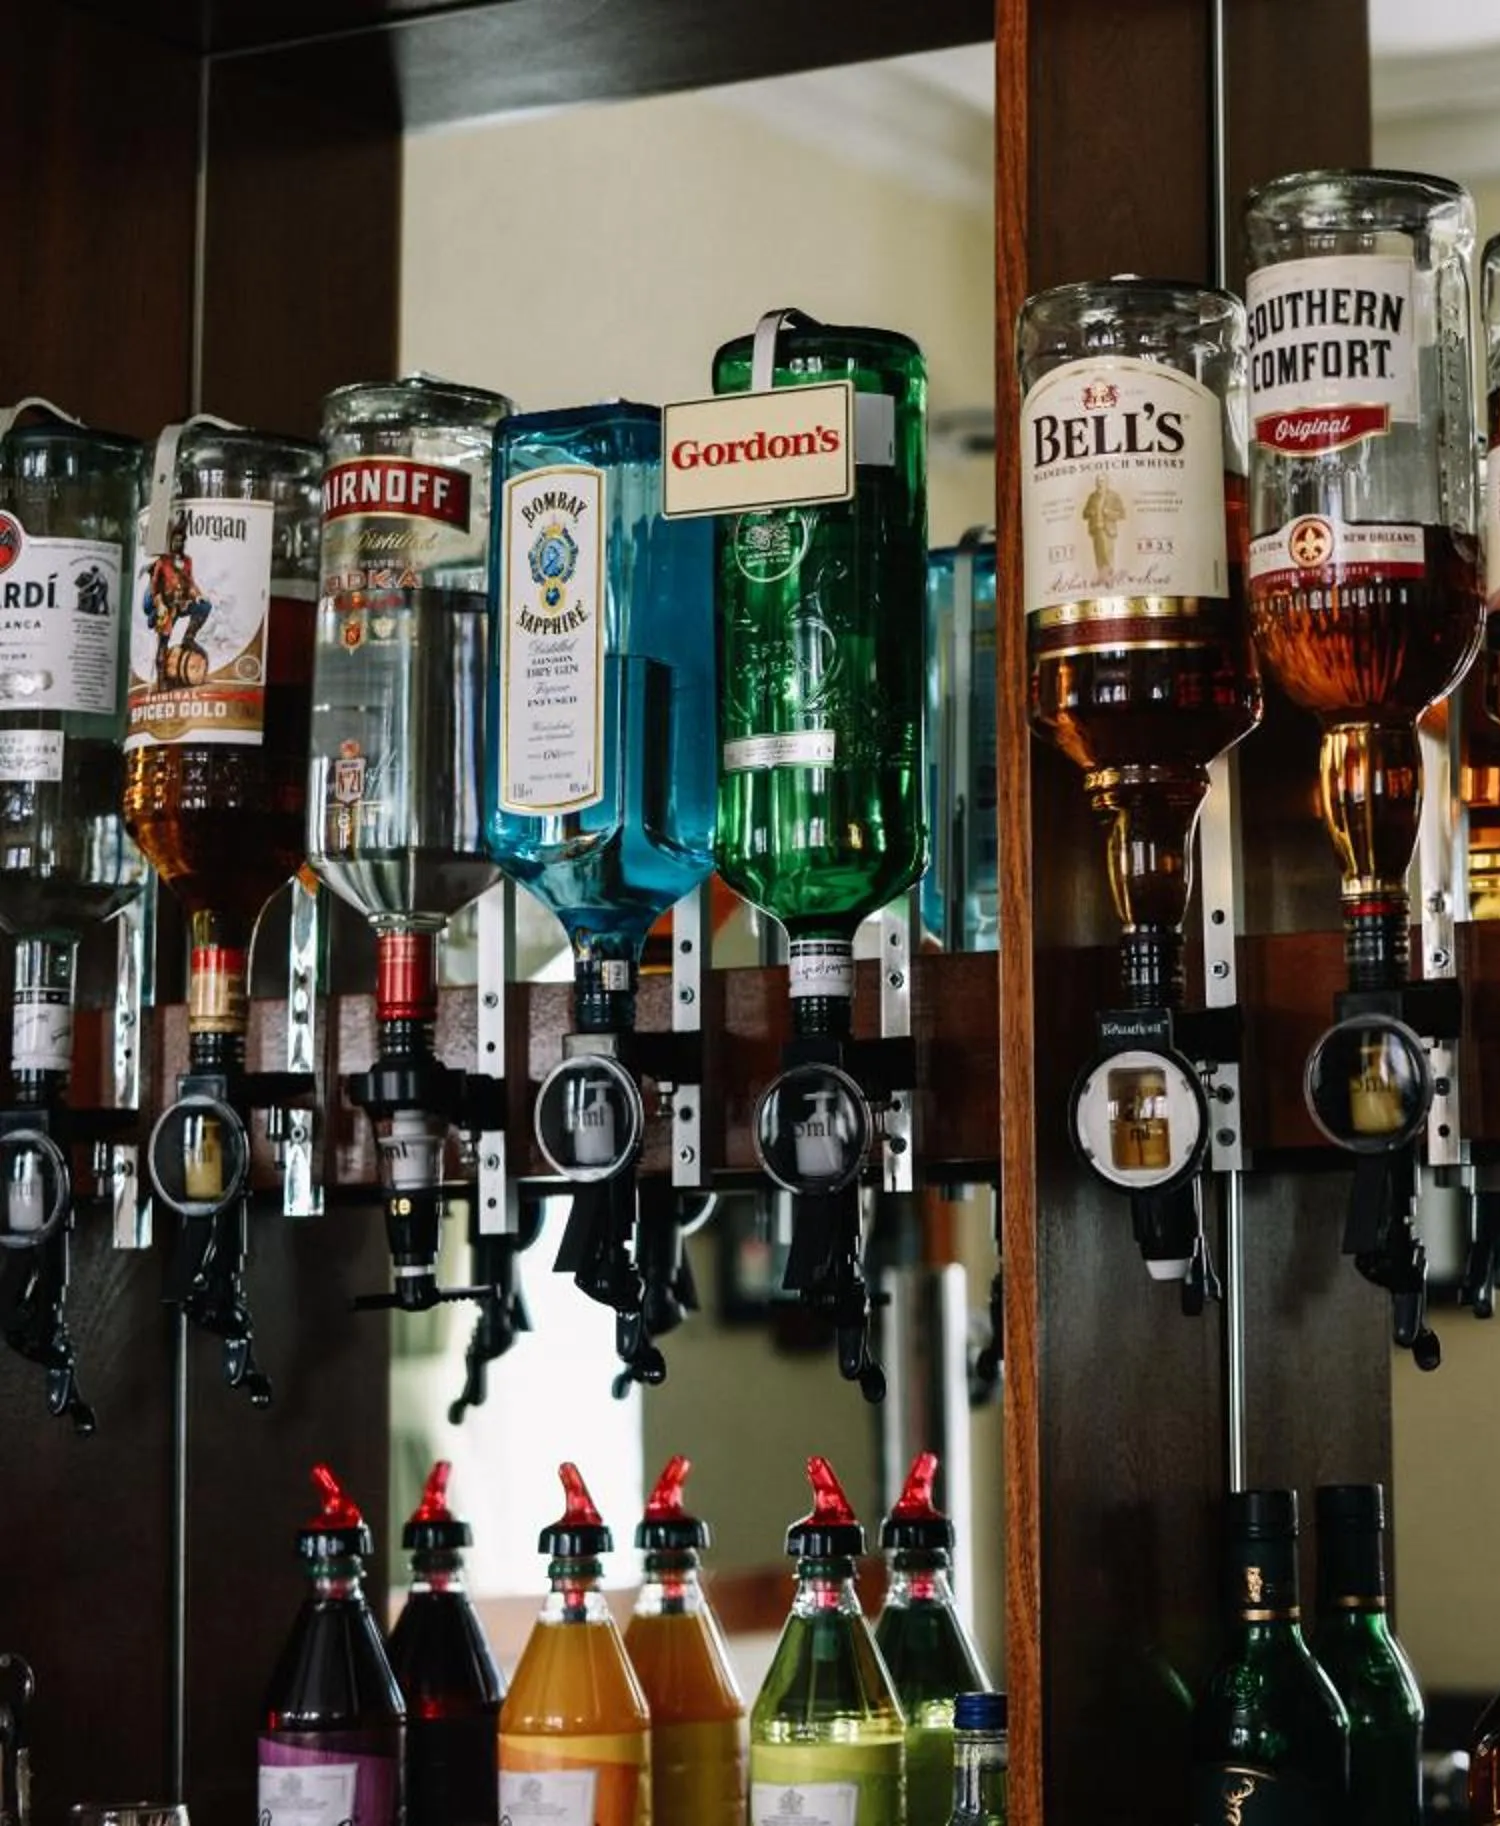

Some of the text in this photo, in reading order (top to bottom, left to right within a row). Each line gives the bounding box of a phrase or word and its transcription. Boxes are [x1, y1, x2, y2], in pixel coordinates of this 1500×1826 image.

[1249, 288, 1404, 348] SOUTHERN
[1252, 339, 1392, 393] COMFORT
[1033, 402, 1186, 468] BELL'S
[1275, 415, 1351, 441] Original
[671, 425, 841, 471] Gordon's
[322, 469, 451, 513] MIRNOFF
[522, 490, 588, 528] BOMBAY
[175, 508, 247, 541] Morgan
[0, 572, 58, 609] RDÍ
[517, 601, 589, 635] SAPPHIRE
[131, 701, 228, 724] SPICED GOLD
